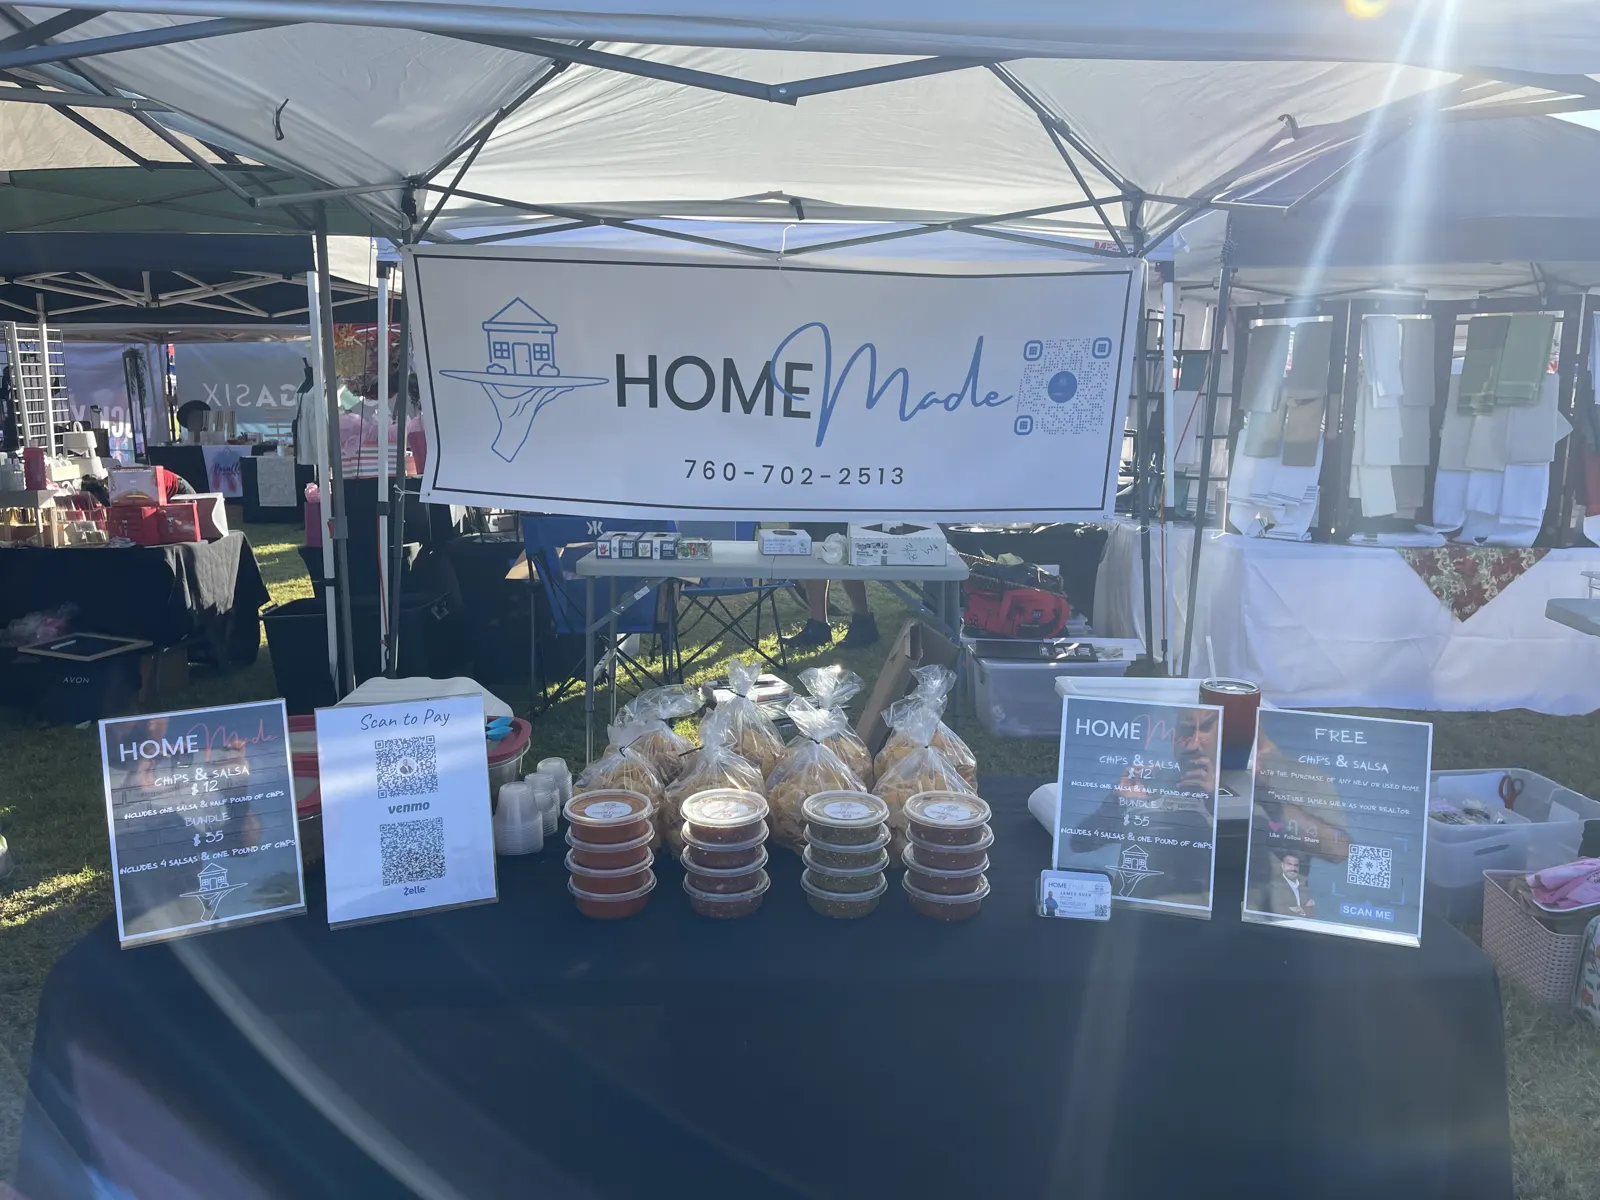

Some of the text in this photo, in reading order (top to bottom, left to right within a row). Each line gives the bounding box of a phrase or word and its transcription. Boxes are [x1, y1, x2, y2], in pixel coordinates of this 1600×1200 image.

[615, 321, 1014, 448] HOME Made
[684, 459, 904, 485] 760-702-2513
[62, 676, 90, 684] AVON
[360, 708, 451, 731] Scan to Pay
[1075, 718, 1141, 740] HOME
[1315, 728, 1367, 744] FREE
[119, 717, 279, 762] HOME Made
[1098, 754, 1181, 772] CHIPS & SALSA
[1298, 754, 1389, 774] CHIPS & SALSA
[154, 765, 250, 787] CHIPS & SALSA
[1276, 770, 1288, 778] THE
[1291, 772, 1324, 782] PURCHASE
[1382, 782, 1400, 790] USED
[1401, 784, 1420, 792] HOME
[1071, 780, 1098, 788] INCLUDES
[1114, 784, 1131, 792] SALSA
[1133, 784, 1141, 792] &
[1142, 785, 1158, 795] HALF
[1160, 788, 1179, 797] POUND
[124, 809, 158, 820] INCLUDES
[159, 806, 174, 814] ONE
[176, 803, 198, 812] SALSA
[200, 799, 208, 808] &
[209, 798, 228, 807] HALF
[229, 795, 252, 804] POUND
[388, 801, 430, 815] venmo
[1118, 796, 1159, 809] BUNDLE
[1307, 797, 1327, 805] JAMES
[1379, 806, 1410, 815] REALTOR
[184, 812, 231, 827] BUNDLE
[1060, 827, 1092, 837] INCLUDES
[1093, 828, 1099, 837] 4
[1100, 831, 1125, 841] SALSAS
[1127, 831, 1135, 841] &
[1137, 835, 1152, 843] ONE
[1155, 836, 1178, 846] POUND
[1283, 833, 1301, 841] Follow
[1304, 836, 1320, 844] Share
[119, 838, 296, 875] INCLUDES 4 SALSAS & ONE POUND OF CHIPS
[403, 885, 426, 896] Zelle
[1343, 905, 1391, 920] SCAN ME
